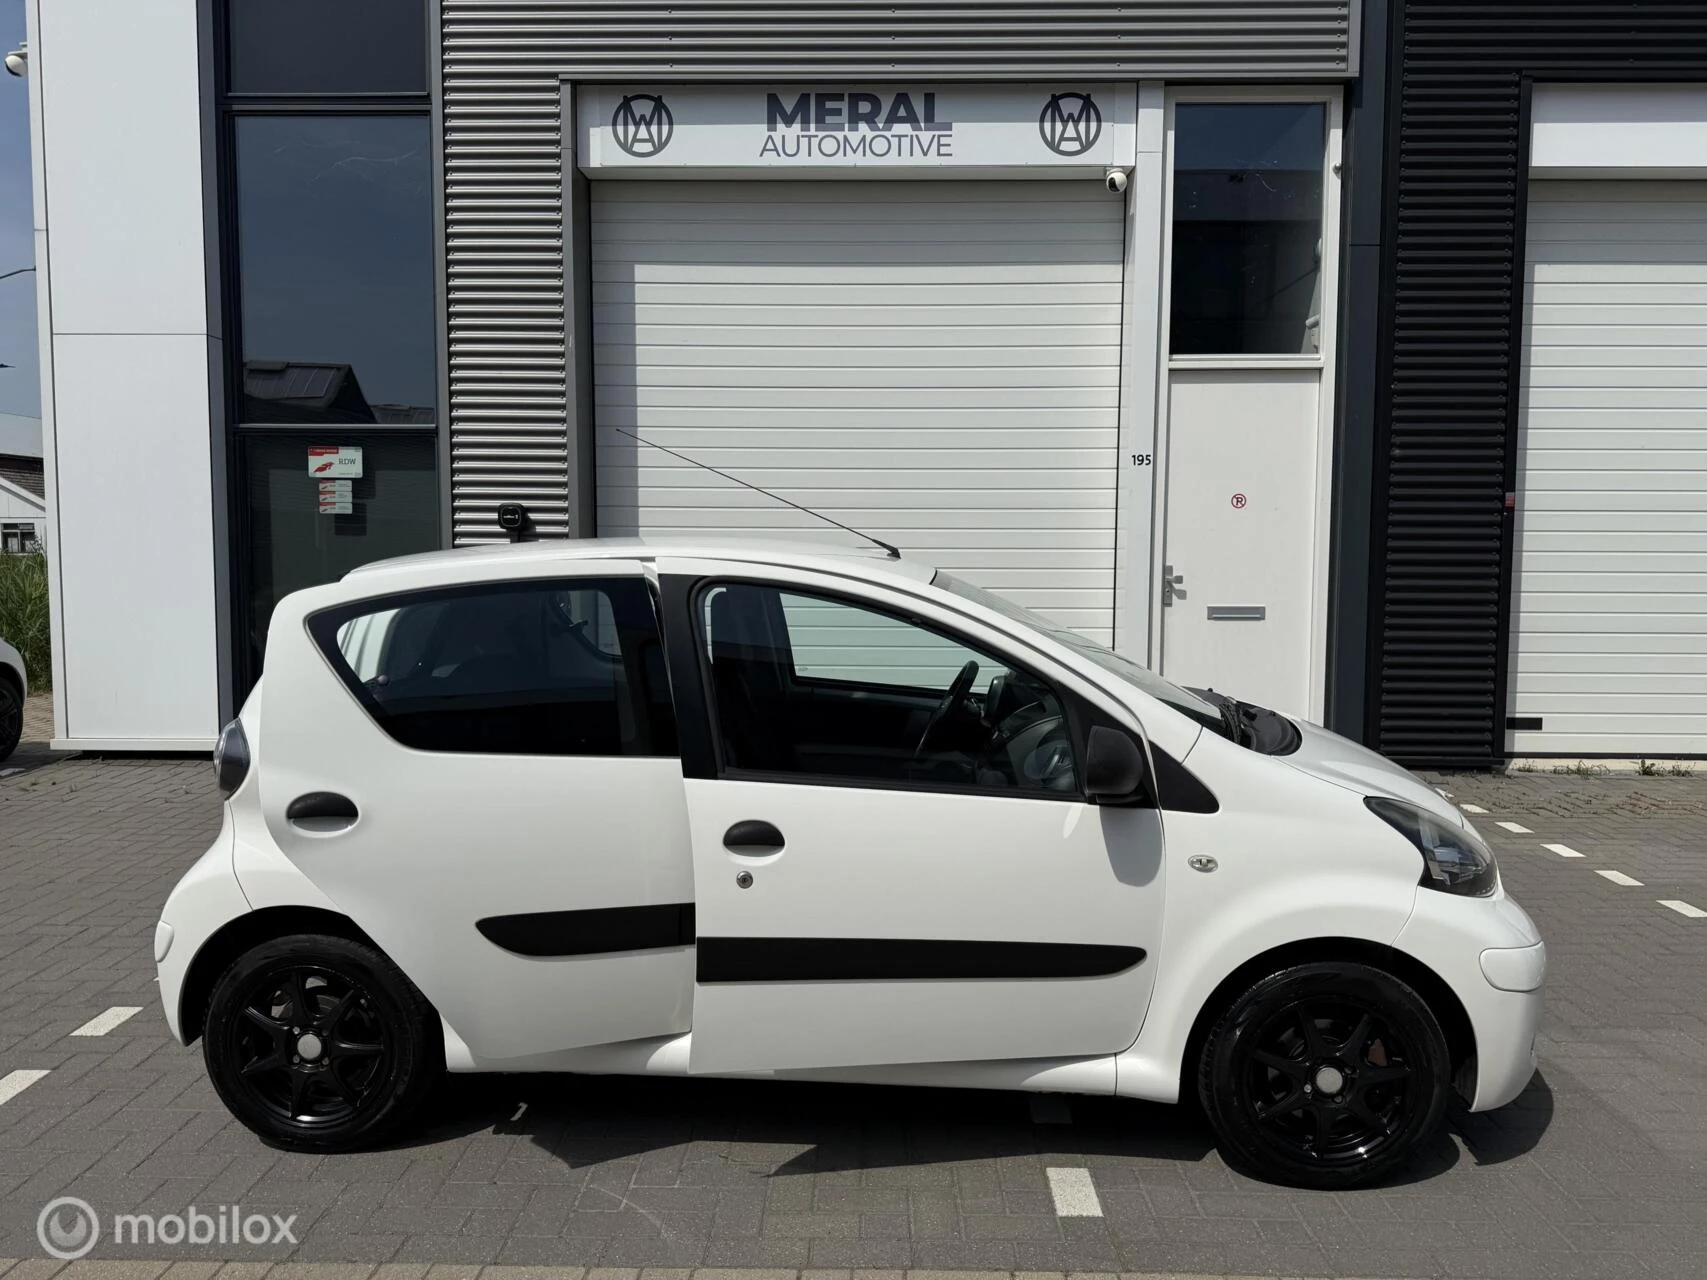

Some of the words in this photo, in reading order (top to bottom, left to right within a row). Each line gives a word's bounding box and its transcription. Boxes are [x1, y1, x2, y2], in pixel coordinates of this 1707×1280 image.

[767, 92, 953, 132] MERAL
[759, 133, 953, 158] AUTOMOTIVE
[1131, 454, 1151, 466] 195
